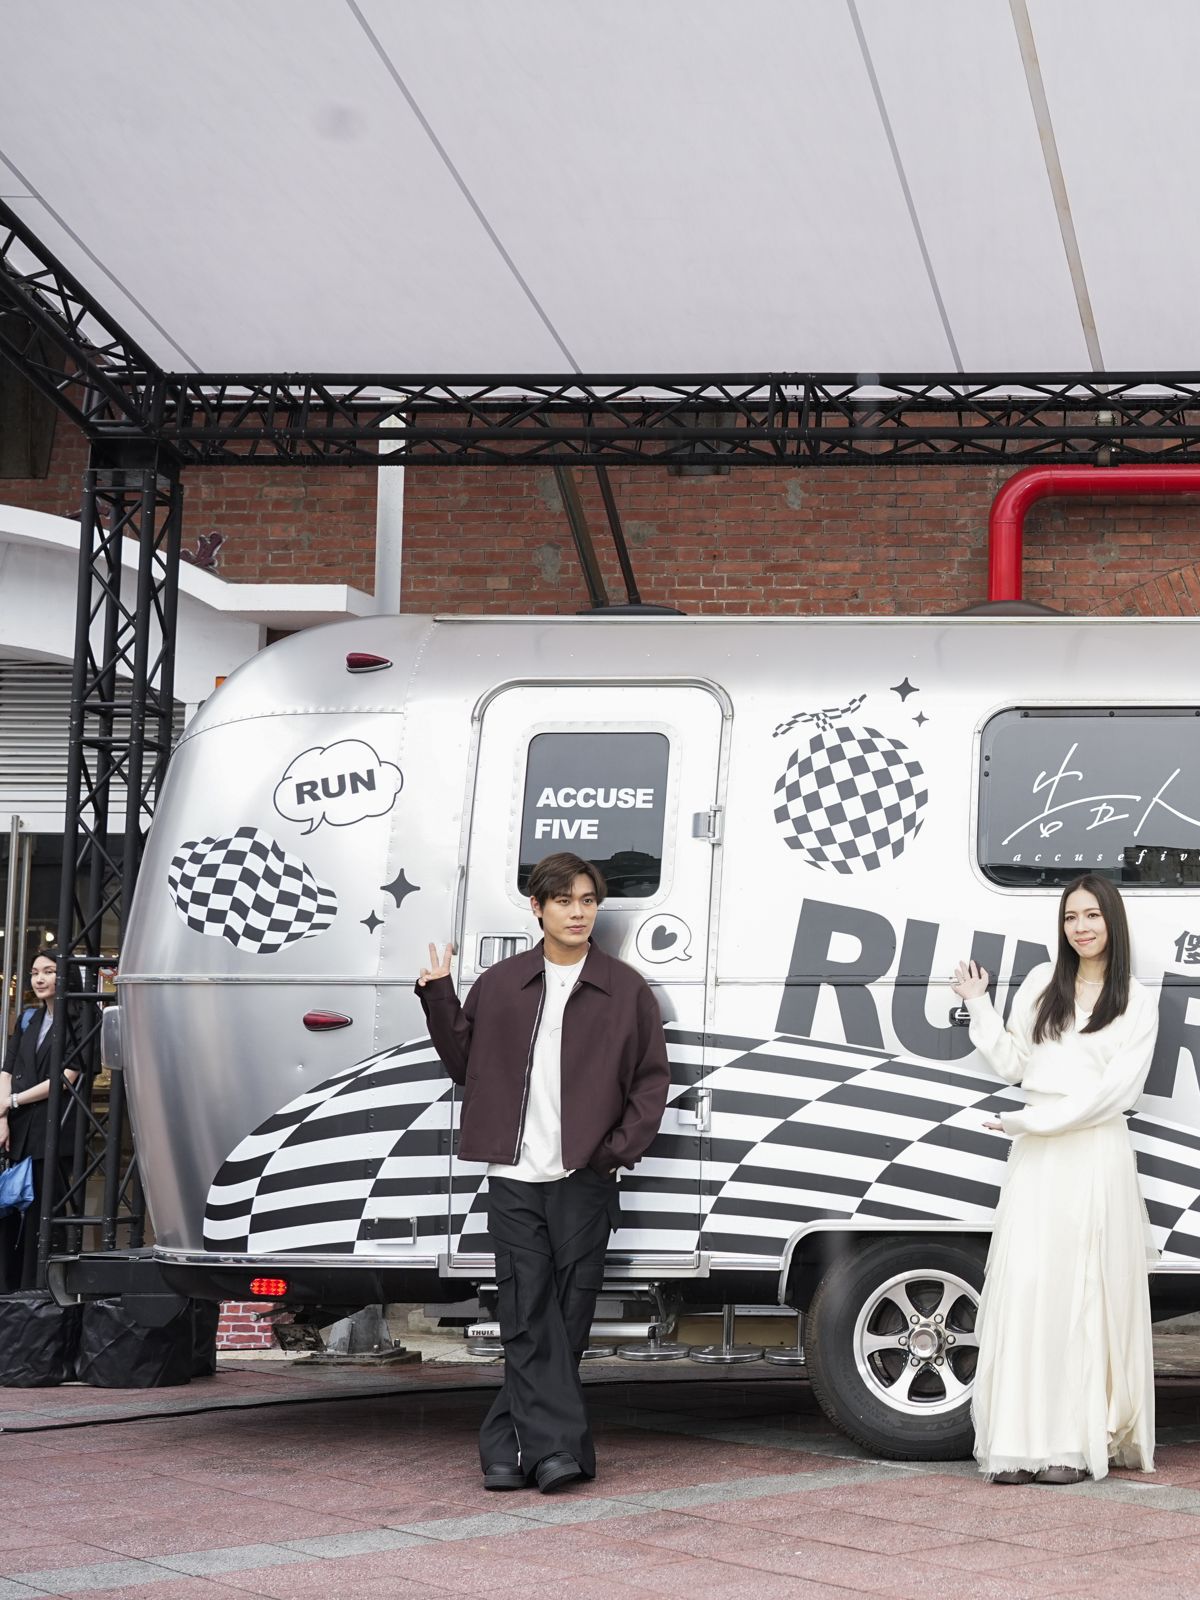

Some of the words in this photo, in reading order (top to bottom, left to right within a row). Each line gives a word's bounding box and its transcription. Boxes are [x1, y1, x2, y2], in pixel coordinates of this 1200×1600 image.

[295, 769, 376, 805] RUN
[536, 787, 655, 809] ACCUSE
[535, 818, 599, 840] FIVE
[775, 898, 1051, 1060] RU
